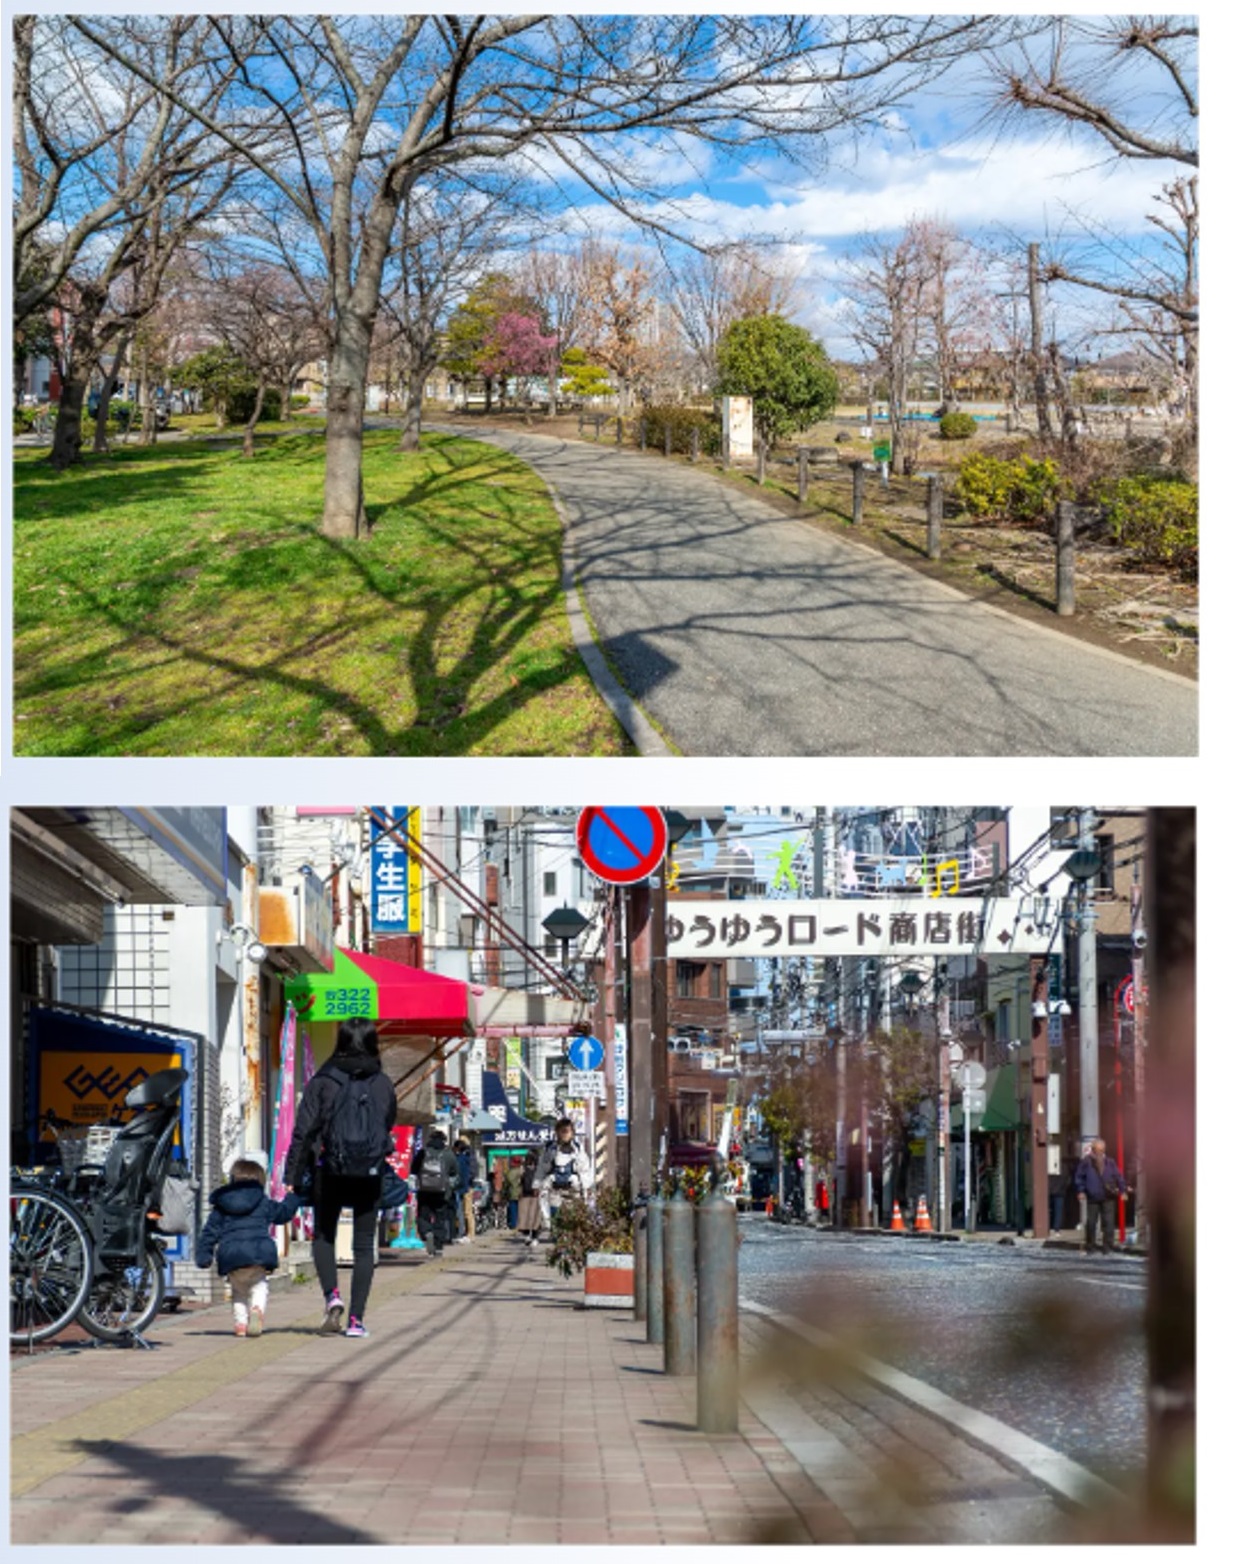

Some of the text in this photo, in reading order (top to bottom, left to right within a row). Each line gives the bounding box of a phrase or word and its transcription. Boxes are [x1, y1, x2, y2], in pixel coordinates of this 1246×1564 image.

[375, 806, 405, 922] 学生服
[337, 988, 371, 1002] 322
[325, 1002, 371, 1016] 2962
